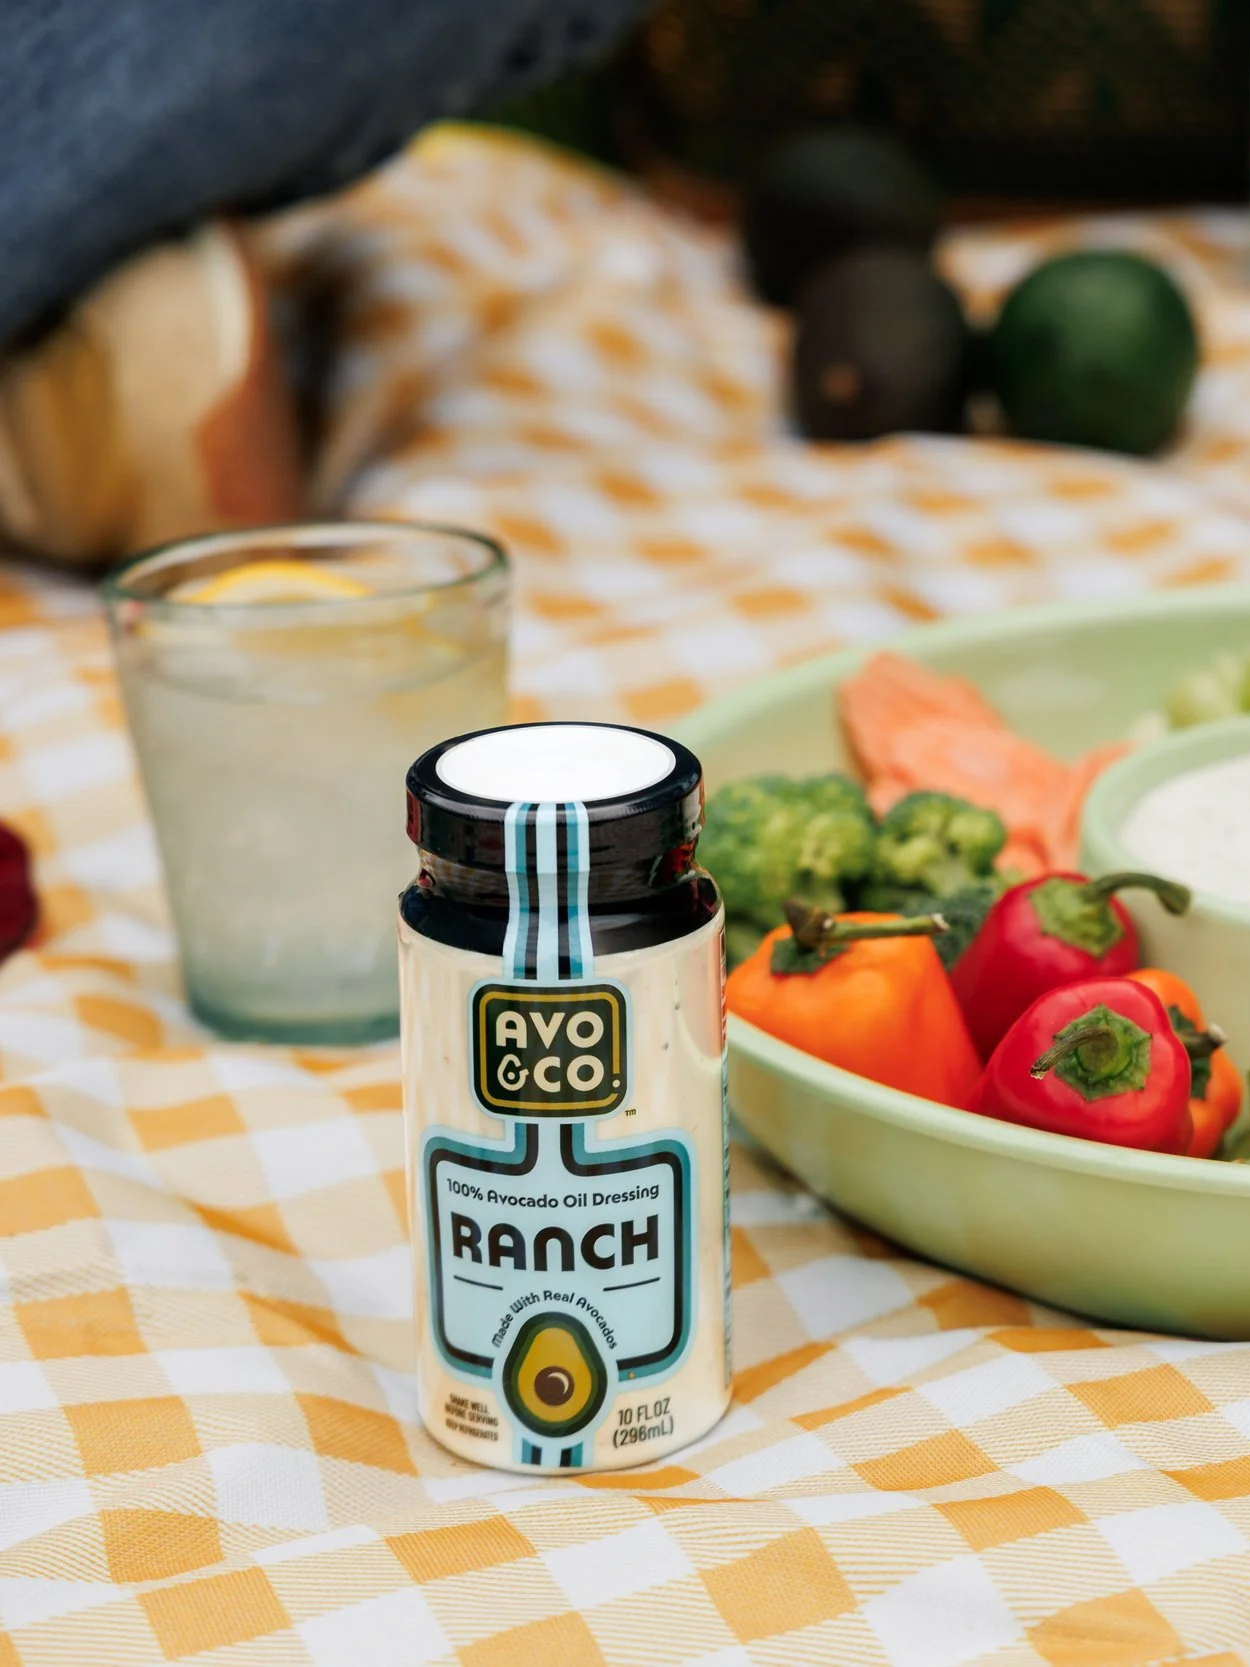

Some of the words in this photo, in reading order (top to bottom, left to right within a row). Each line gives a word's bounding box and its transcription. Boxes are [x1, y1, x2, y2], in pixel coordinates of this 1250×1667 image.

[496, 1010, 605, 1049] AVO
[447, 1178, 484, 1201] 100%
[487, 1189, 559, 1208] Avocado
[563, 1192, 587, 1208] Oil
[592, 1184, 660, 1207] Dressing
[450, 1210, 659, 1272] RANCH
[491, 1313, 514, 1348] Made
[509, 1292, 540, 1314] With
[543, 1290, 575, 1303] Real
[576, 1297, 618, 1350] Avocados
[613, 1414, 674, 1449] (296mL)
[618, 1407, 633, 1426] 10
